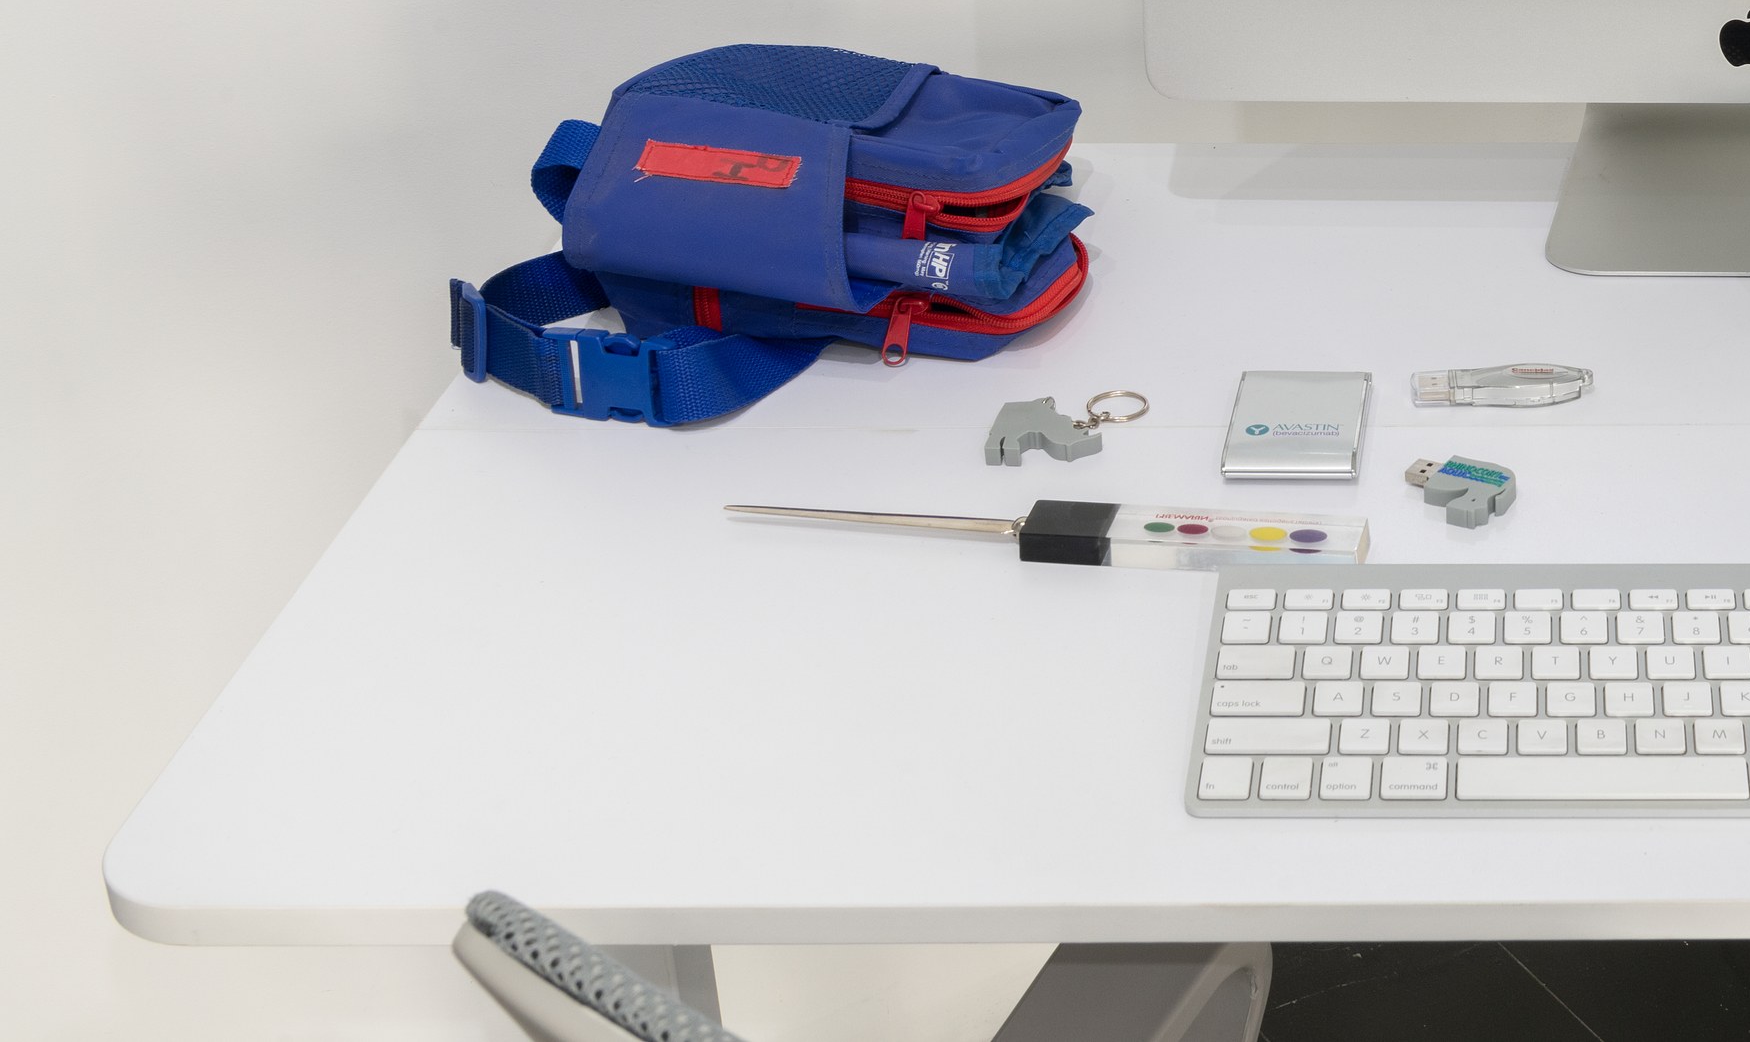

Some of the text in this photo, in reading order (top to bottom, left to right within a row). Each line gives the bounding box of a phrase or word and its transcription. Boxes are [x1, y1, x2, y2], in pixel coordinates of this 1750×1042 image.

[1272, 423, 1341, 431] AVASTIN
[1354, 626, 1362, 636] 2
[1410, 626, 1419, 636] 3
[1467, 626, 1476, 636] 4
[1523, 626, 1532, 636] 5
[1579, 626, 1588, 636] 6
[1636, 626, 1645, 636] 7
[1692, 626, 1701, 636] 8
[1320, 655, 1333, 666] Q
[1377, 655, 1392, 666] W
[1437, 655, 1445, 666] E
[1494, 655, 1503, 666] R
[1551, 656, 1560, 666] T
[1608, 655, 1618, 666] Y
[1664, 655, 1676, 666] U
[1222, 663, 1239, 671] tab
[1332, 691, 1344, 702] A
[1392, 691, 1401, 702] S
[1449, 691, 1460, 702] D
[1509, 691, 1517, 702] F
[1564, 692, 1577, 702] G
[1623, 692, 1635, 702] H
[1683, 691, 1690, 702] J
[1216, 699, 1262, 709] caps lock
[1359, 728, 1371, 740] Z
[1417, 729, 1429, 740] X
[1477, 729, 1488, 740] C
[1536, 729, 1548, 741] V
[1596, 729, 1606, 740] B
[1654, 729, 1666, 740] N
[1712, 729, 1727, 740] M
[1211, 737, 1232, 745] shift
[1205, 782, 1215, 791] fn
[1265, 782, 1300, 791] control
[1325, 782, 1357, 791] option
[1388, 782, 1439, 791] command
